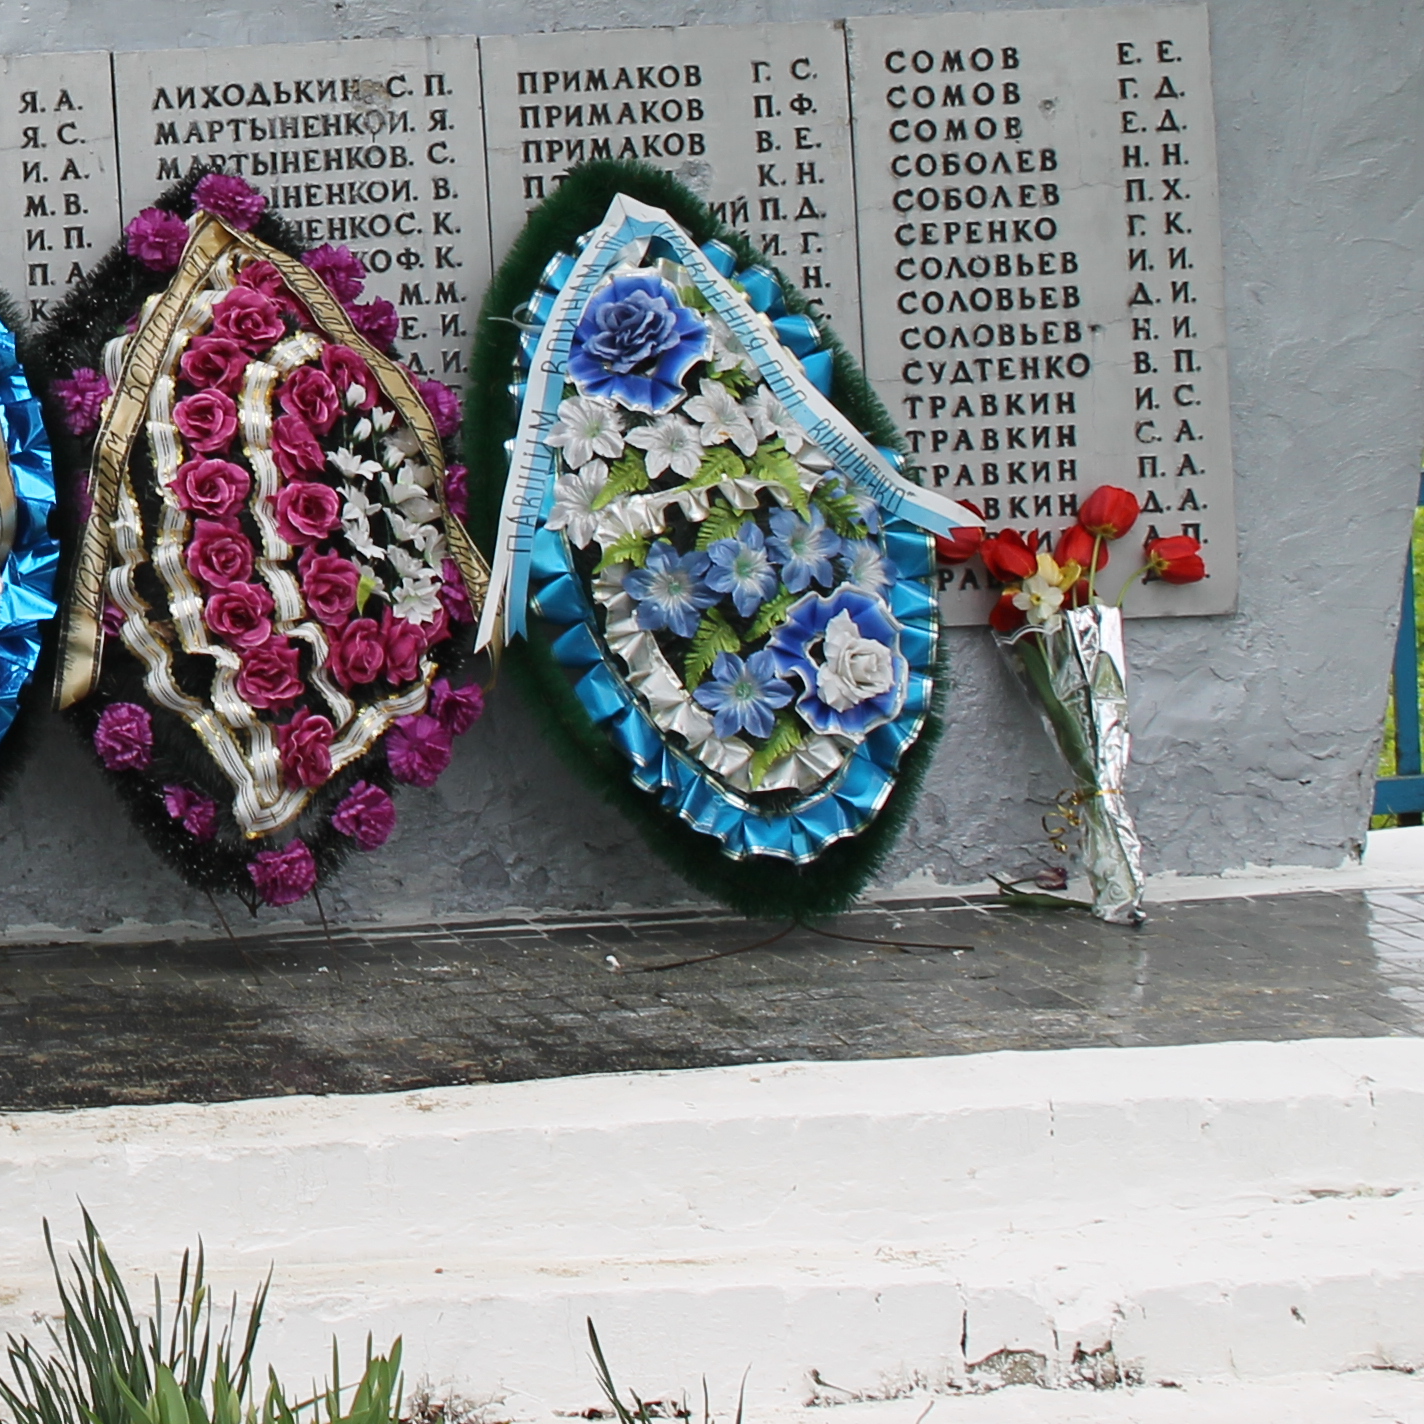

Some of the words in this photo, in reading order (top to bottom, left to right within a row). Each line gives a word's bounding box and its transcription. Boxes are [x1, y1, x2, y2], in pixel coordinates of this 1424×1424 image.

[885, 47, 1019, 74] СОМОВ
[517, 65, 701, 95] ПРИМАКОВ
[887, 82, 1020, 109] СОМОВ
[519, 99, 704, 128] ПРИМАКОВ
[889, 117, 1022, 143] СОМОВ
[522, 133, 705, 163] ПРИМАКОВ
[891, 148, 1057, 179] СОБОЛЕВ
[893, 184, 1059, 213] СОБОЛЕВ
[895, 217, 1057, 247] СЕРЕНКО
[896, 252, 1078, 281] СОЛОВЬЕВ
[897, 286, 1080, 315] СОЛОВЬЕВ
[900, 321, 1081, 350] СОЛОВЬЕВ
[902, 353, 1090, 385] СУДТЕНКО
[903, 392, 1075, 419] ТРАВКИН
[905, 425, 1076, 453] ТРАВКИН
[507, 408, 558, 554] ПАВШИМ
